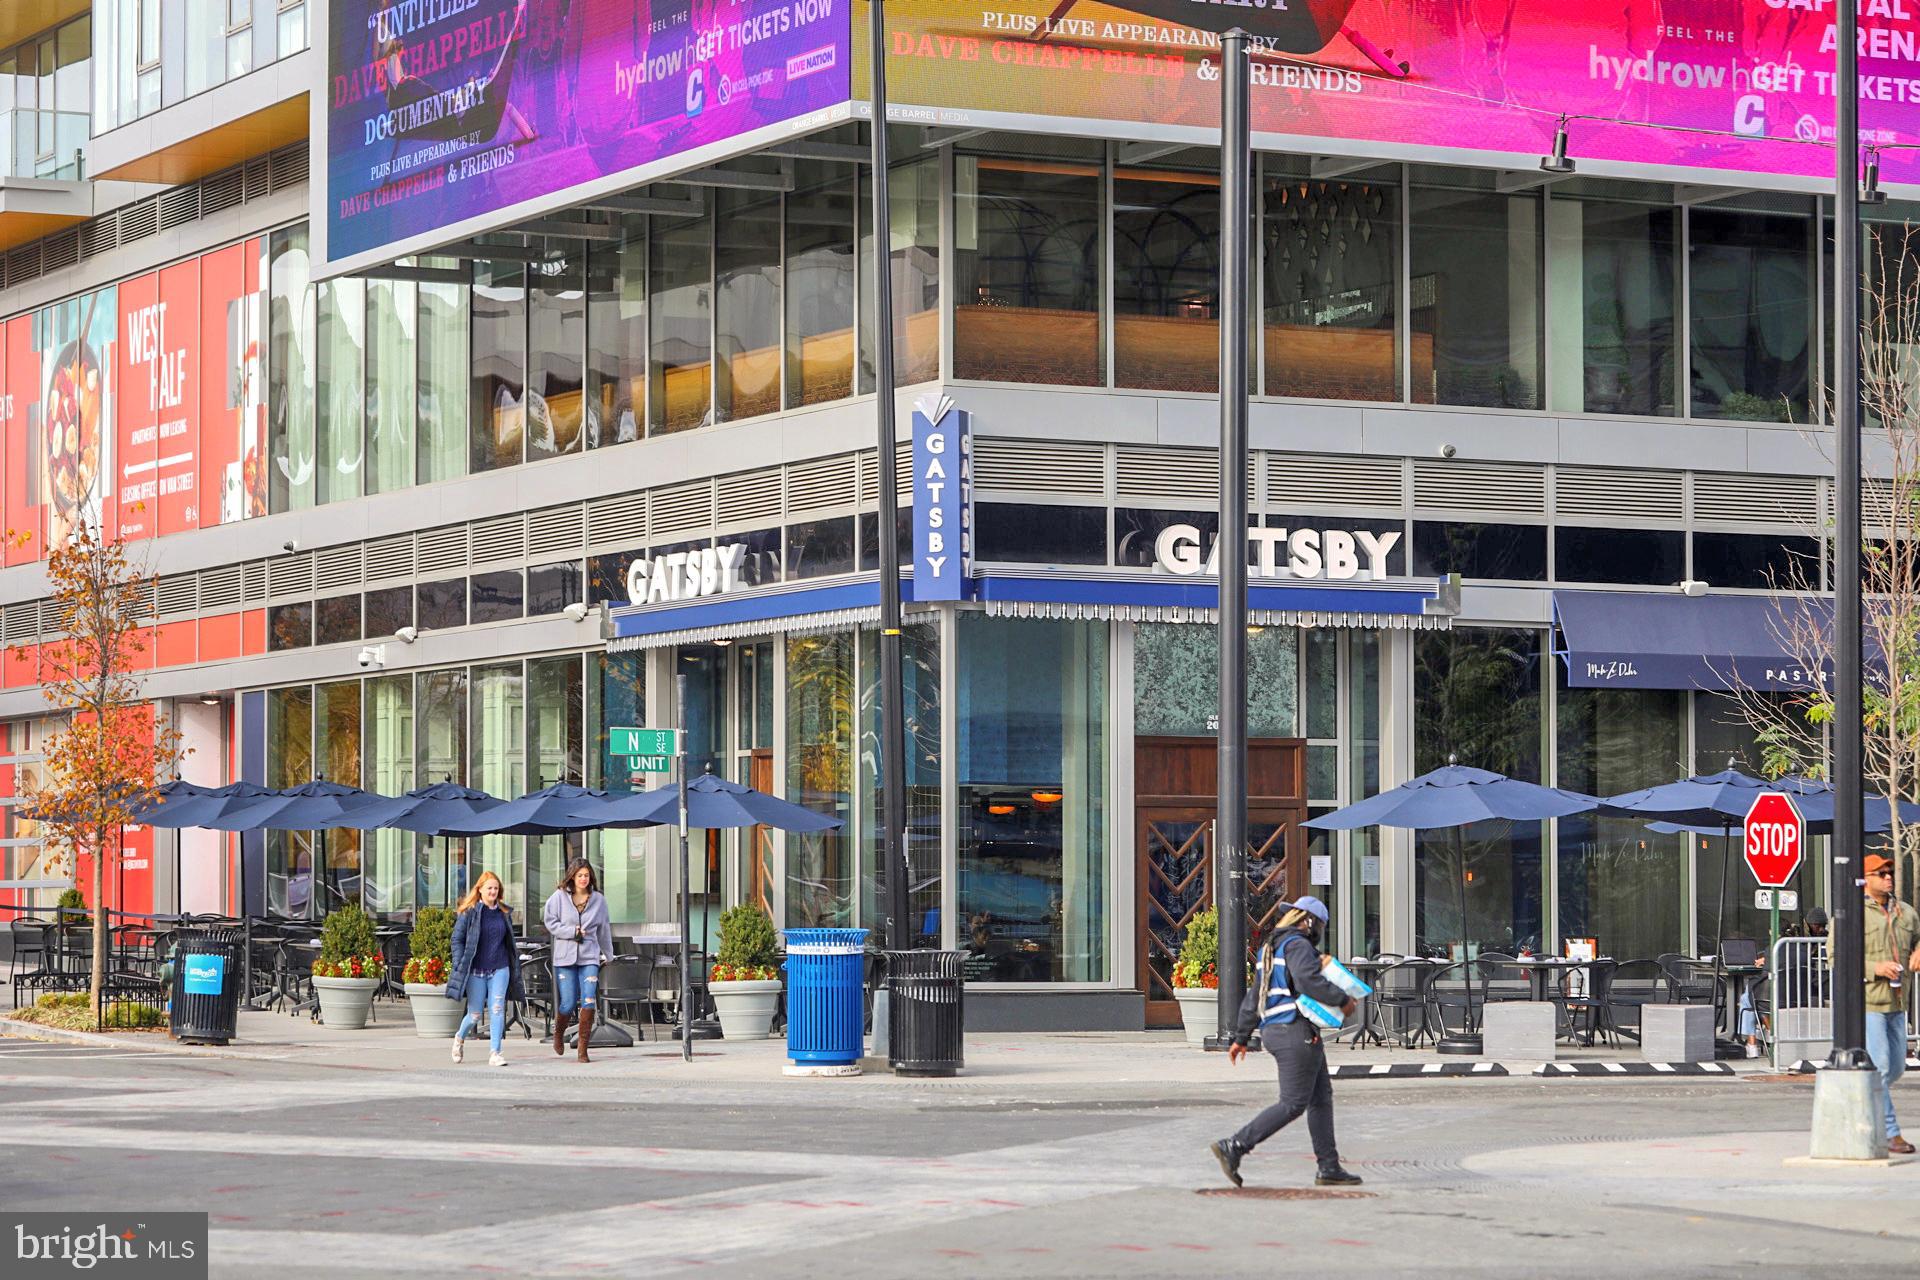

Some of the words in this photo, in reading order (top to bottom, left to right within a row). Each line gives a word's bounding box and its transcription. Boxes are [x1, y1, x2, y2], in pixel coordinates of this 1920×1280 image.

[368, 0, 478, 43] “UNTITL
[648, 18, 667, 34] FEEL
[672, 10, 688, 26] THE
[696, 28, 724, 62] GET
[728, 7, 790, 50] TICKETS
[794, 0, 832, 28] NOW
[982, 12, 1037, 31] PLUS
[1044, 17, 1095, 36] LIVE
[1101, 22, 1222, 47] APPEARAN
[1252, 35, 1279, 53] BY
[1657, 25, 1694, 39] FEEL
[1705, 29, 1735, 43] THE
[1819, 24, 1920, 61] AEN
[334, 57, 388, 109] DAVE
[399, 5, 528, 82] CHAPPELLE
[615, 48, 683, 99] hydrow
[789, 59, 805, 75] LIVE
[805, 51, 833, 69] NATION
[892, 32, 980, 61] DAVE
[992, 40, 1185, 77] CHAPPELLE
[1196, 58, 1219, 81] &
[1250, 63, 1362, 93] RIENDS
[1589, 45, 1726, 91] hydrow
[1751, 65, 1805, 92] GET
[1813, 71, 1920, 104] TIKETS
[364, 76, 487, 146] DOCUMENTARY
[860, 105, 900, 117] OGE
[902, 109, 936, 120] BARREL
[940, 112, 969, 122] MEDIA
[370, 161, 391, 181] PLUS
[392, 154, 411, 174] LIVE
[413, 135, 467, 165] APPEARANCE
[469, 130, 481, 147] BY
[340, 191, 371, 219] DAVE
[374, 164, 445, 208] CHAPPELLE
[447, 163, 457, 184] &
[460, 144, 515, 181] FRIENDS
[128, 302, 167, 366] WEST
[150, 346, 186, 411] HALF
[925, 433, 947, 578] GATSBY
[961, 434, 970, 578] GATSBY
[626, 543, 748, 606] GATSBY
[1766, 670, 1836, 682] PASTR
[628, 731, 639, 752] N
[656, 731, 666, 743] ST
[630, 756, 666, 770] UNIT
[656, 742, 666, 753] SE
[1748, 822, 1797, 856] STOP
